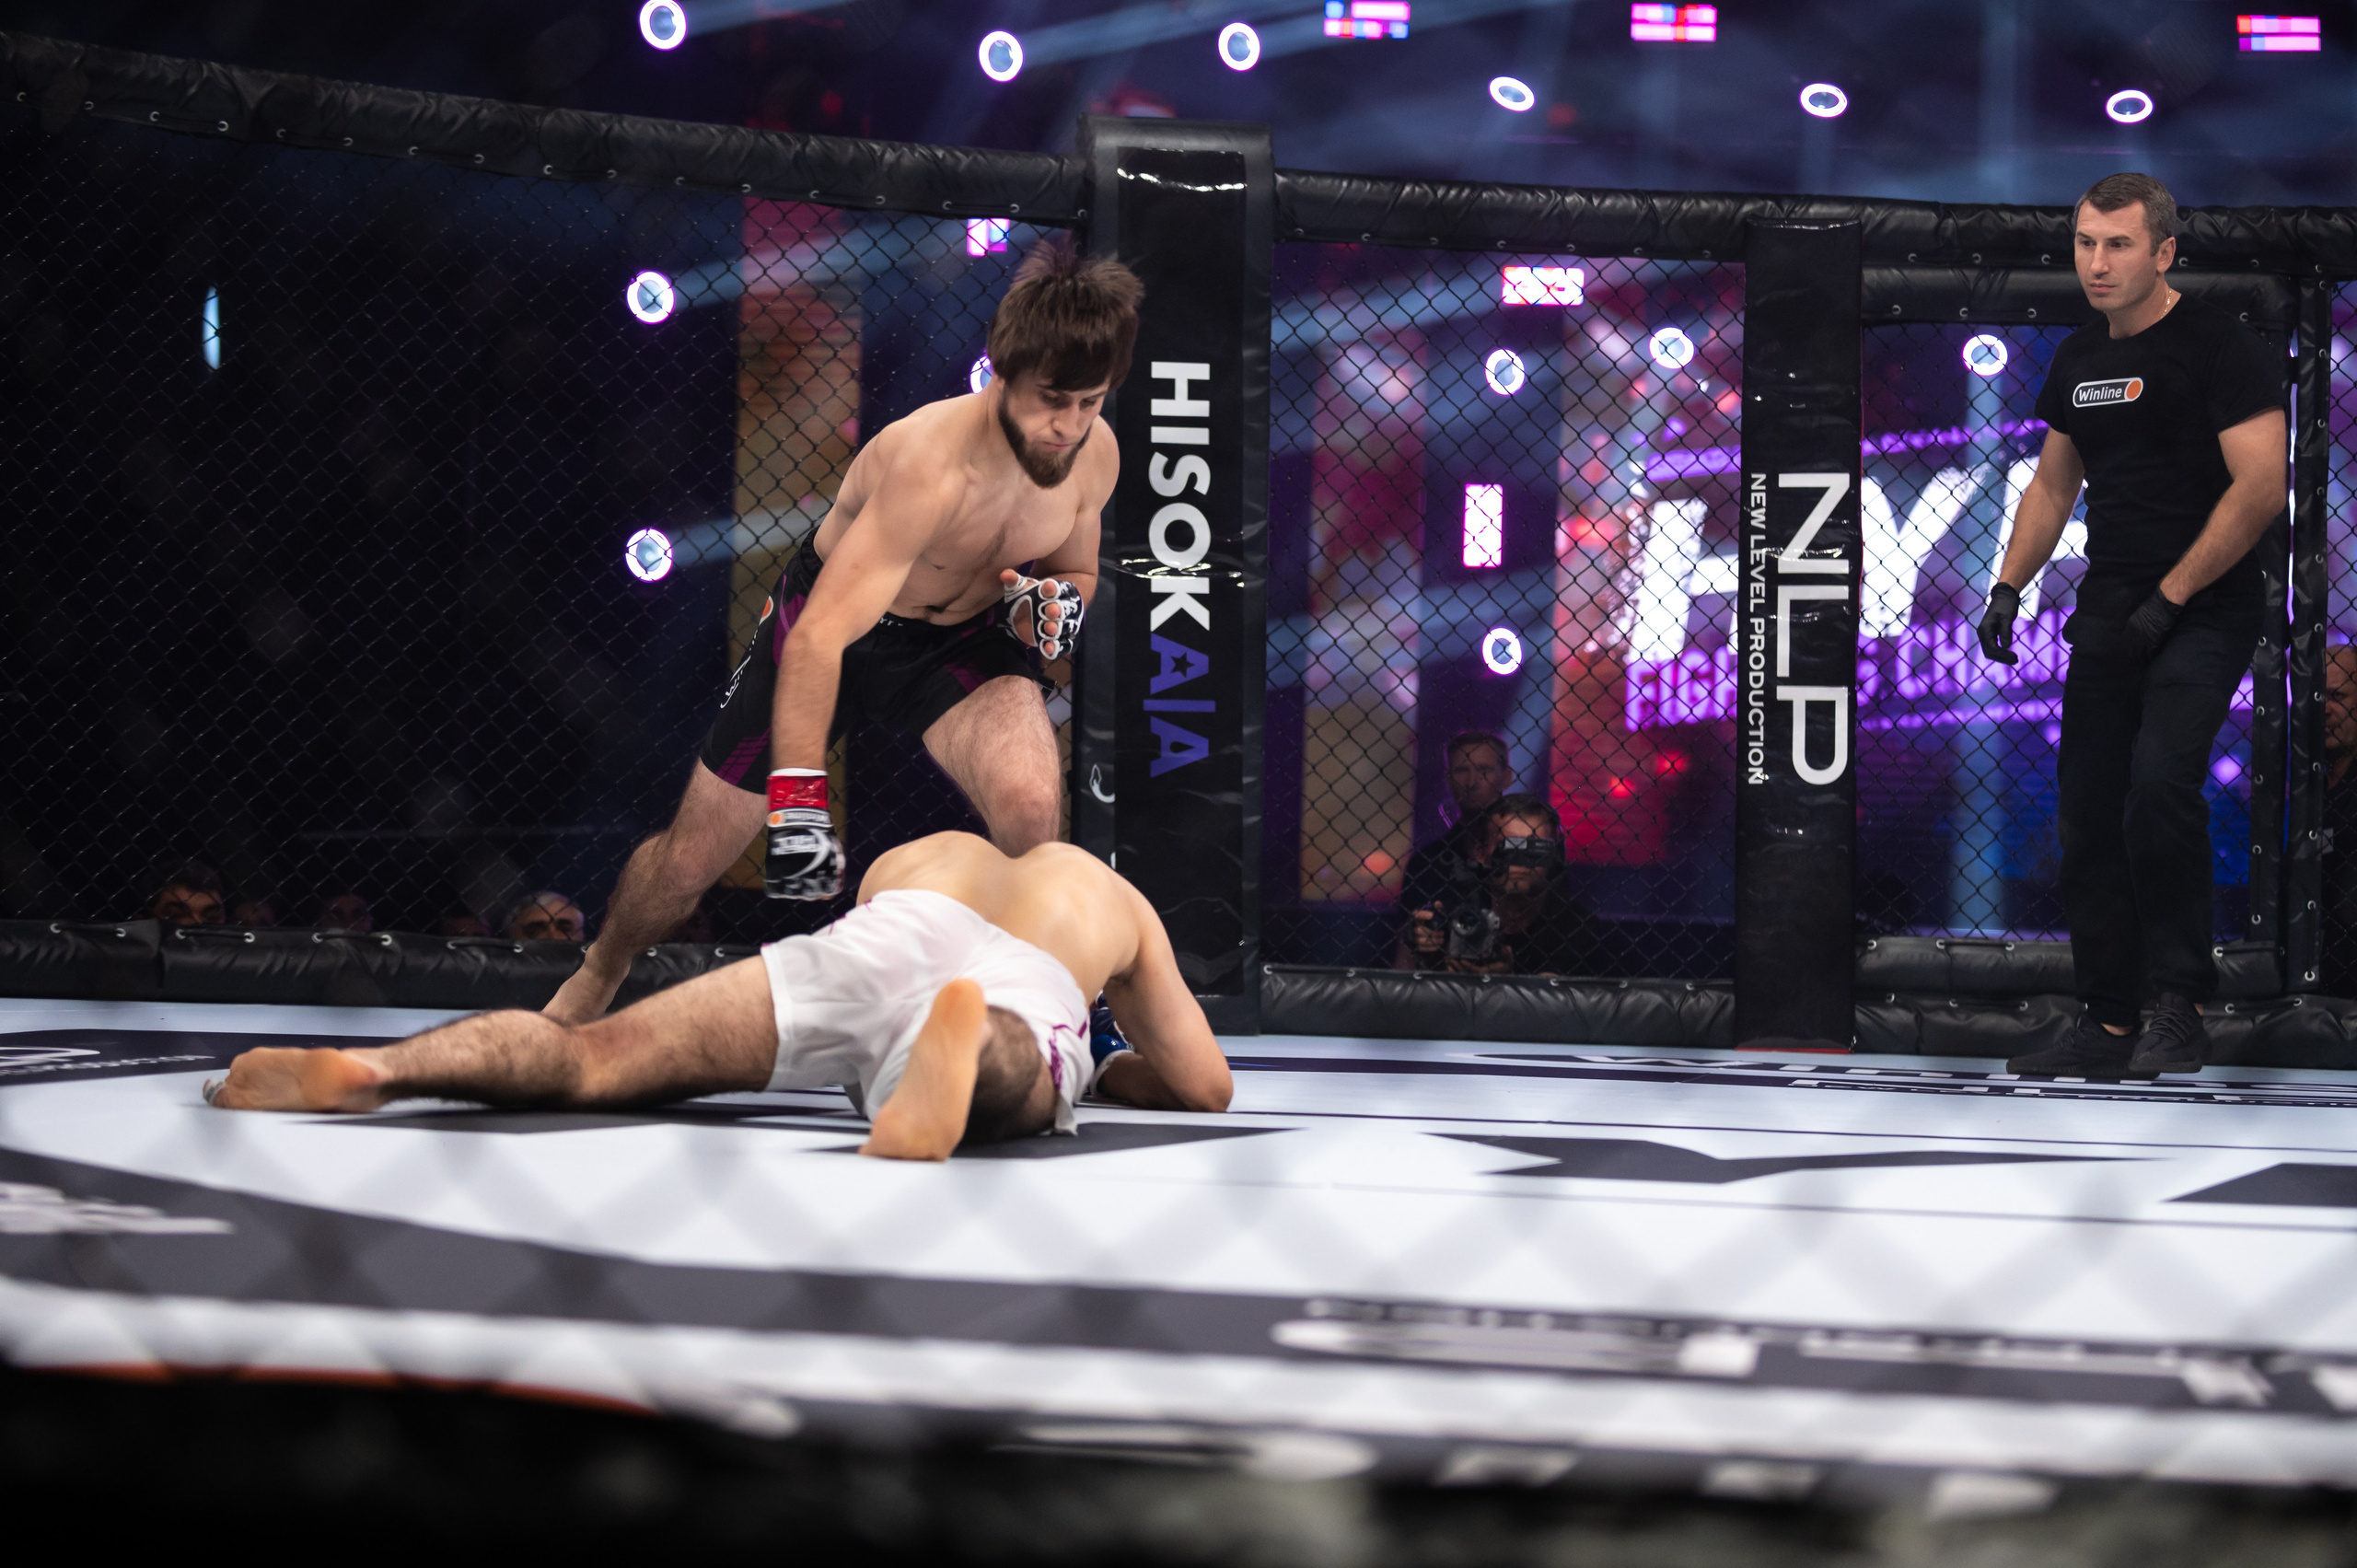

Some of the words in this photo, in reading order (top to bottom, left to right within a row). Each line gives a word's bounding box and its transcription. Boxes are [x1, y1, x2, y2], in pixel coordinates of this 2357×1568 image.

[2078, 386, 2122, 402] Winline
[1750, 472, 1767, 528] NEW
[1749, 535, 1766, 612] LEVEL
[1776, 472, 1850, 786] NLP
[1747, 618, 1766, 785] PRODUCTION
